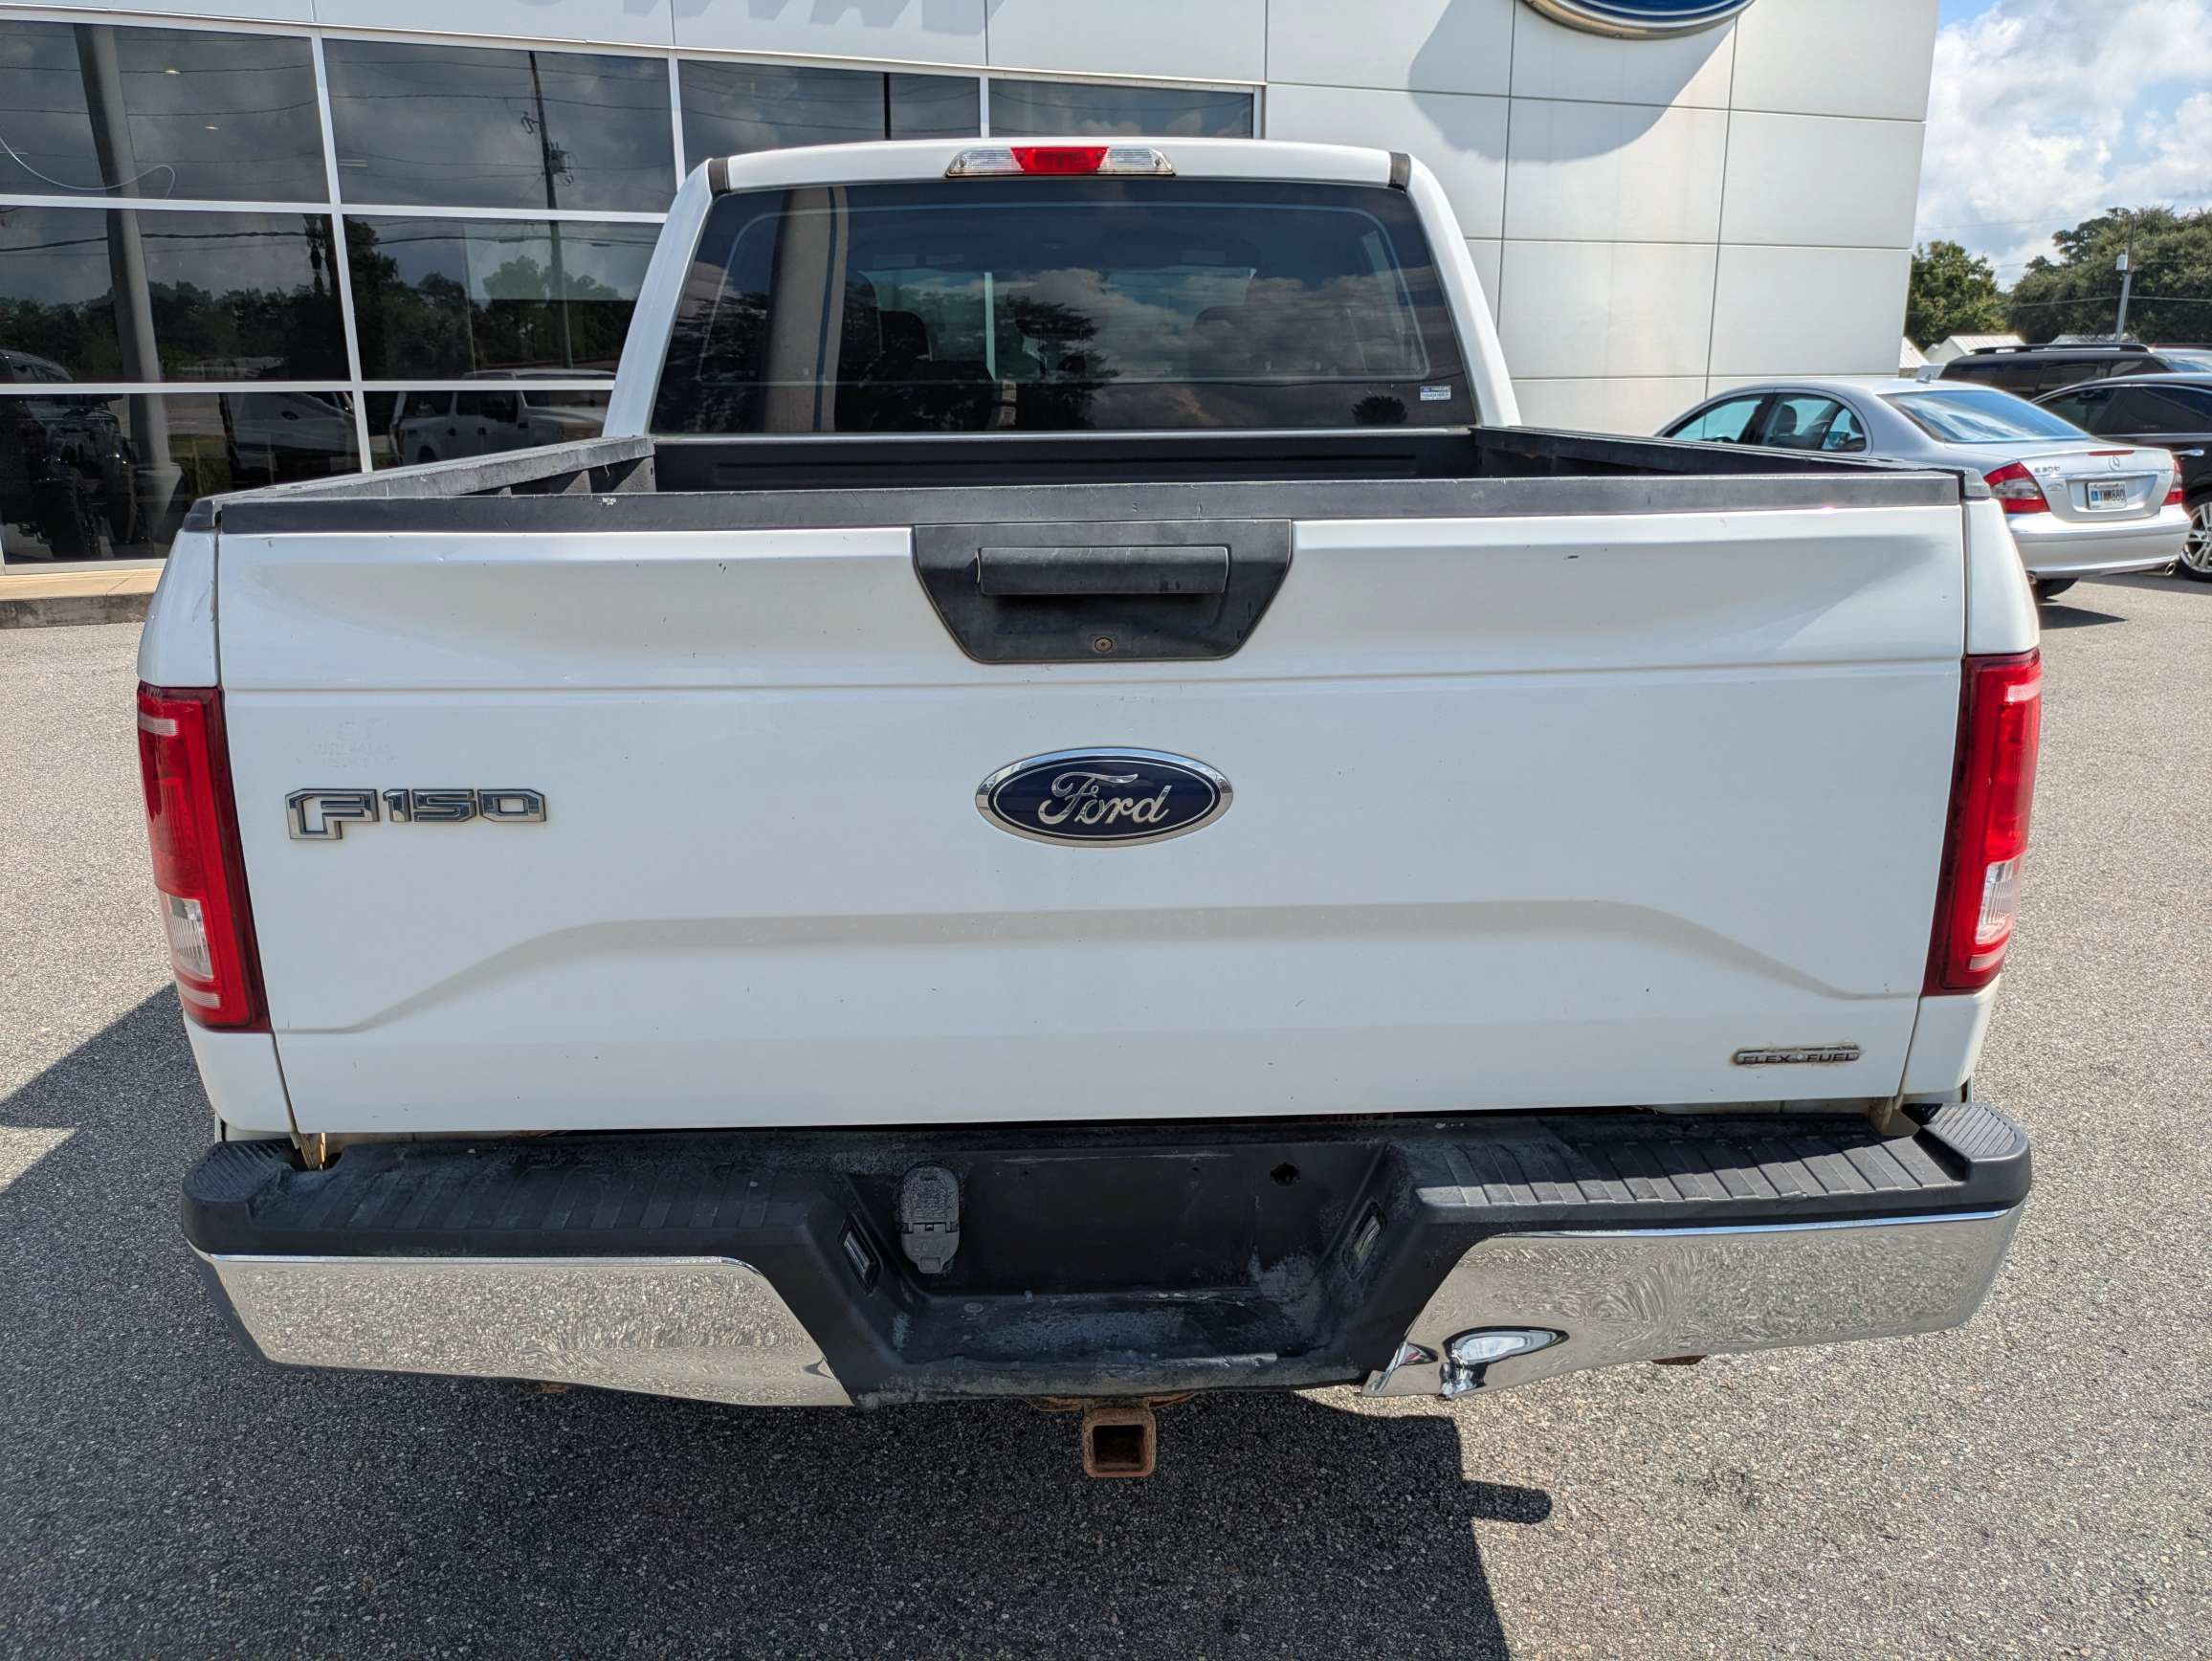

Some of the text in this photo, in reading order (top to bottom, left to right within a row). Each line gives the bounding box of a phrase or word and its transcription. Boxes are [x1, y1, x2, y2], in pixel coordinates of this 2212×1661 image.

[285, 787, 547, 840] F150
[1038, 771, 1172, 824] Ford
[1742, 1052, 1859, 1064] FLEX FUEL
